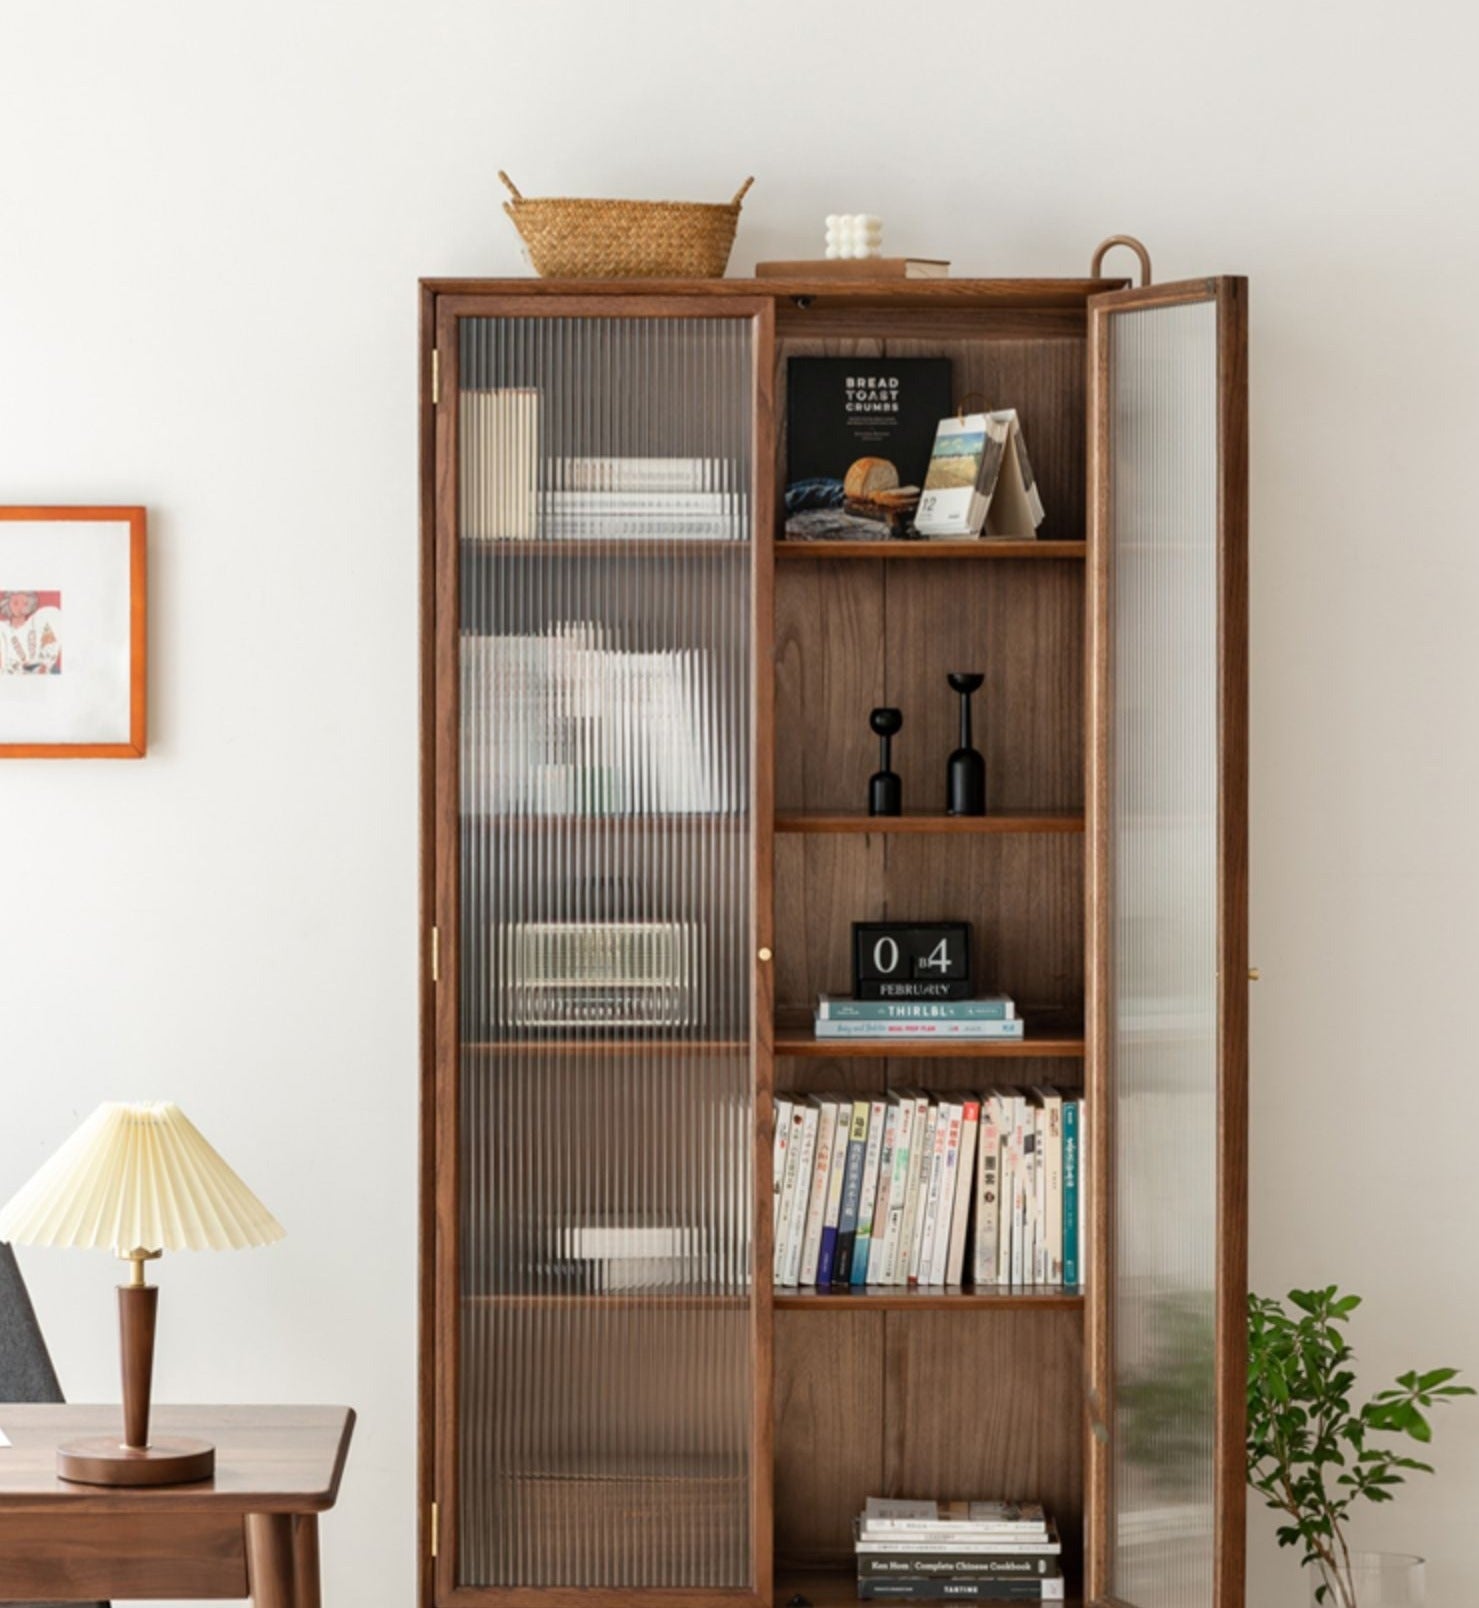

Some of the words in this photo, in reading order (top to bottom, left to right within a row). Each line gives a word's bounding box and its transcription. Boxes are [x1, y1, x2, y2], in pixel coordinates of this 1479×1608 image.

[846, 377, 899, 389] BREAD
[846, 390, 899, 401] TOAST
[846, 402, 899, 412] CRUMBS
[873, 937, 899, 973] 0
[928, 938, 952, 973] 4
[915, 1562, 954, 1571] Complete
[956, 1561, 988, 1570] Chinese
[990, 1562, 1031, 1570] Cookbook
